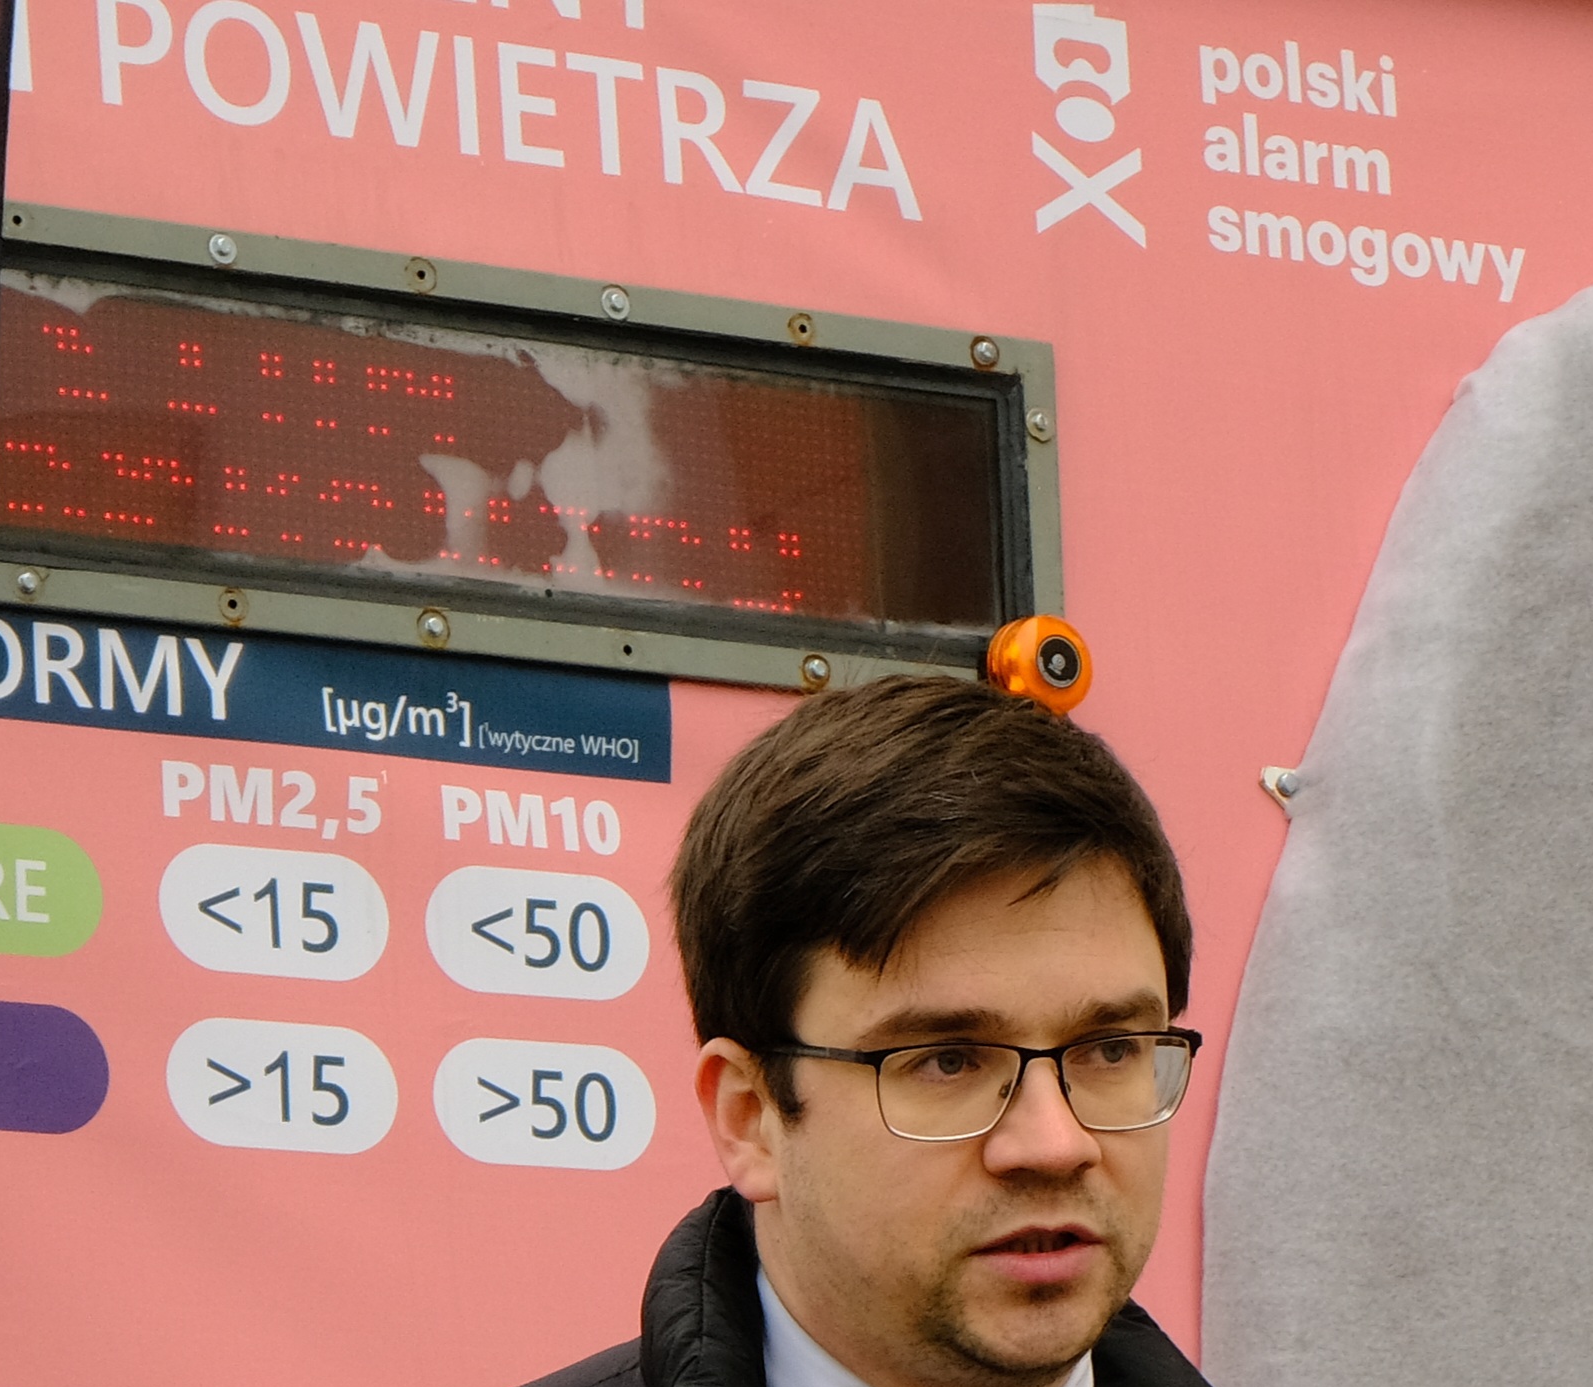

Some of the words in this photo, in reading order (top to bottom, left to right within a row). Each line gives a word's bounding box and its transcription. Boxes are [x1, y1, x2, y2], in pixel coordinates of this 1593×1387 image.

[98, 0, 922, 222] POWIETRZA
[1199, 39, 1397, 118] polski
[1203, 112, 1391, 196] alarm
[1208, 205, 1526, 303] smogowy
[439, 784, 622, 856] PM10
[197, 877, 340, 953] <15
[471, 897, 611, 973] <50
[206, 1050, 350, 1126] >15
[477, 1069, 617, 1143] >50
